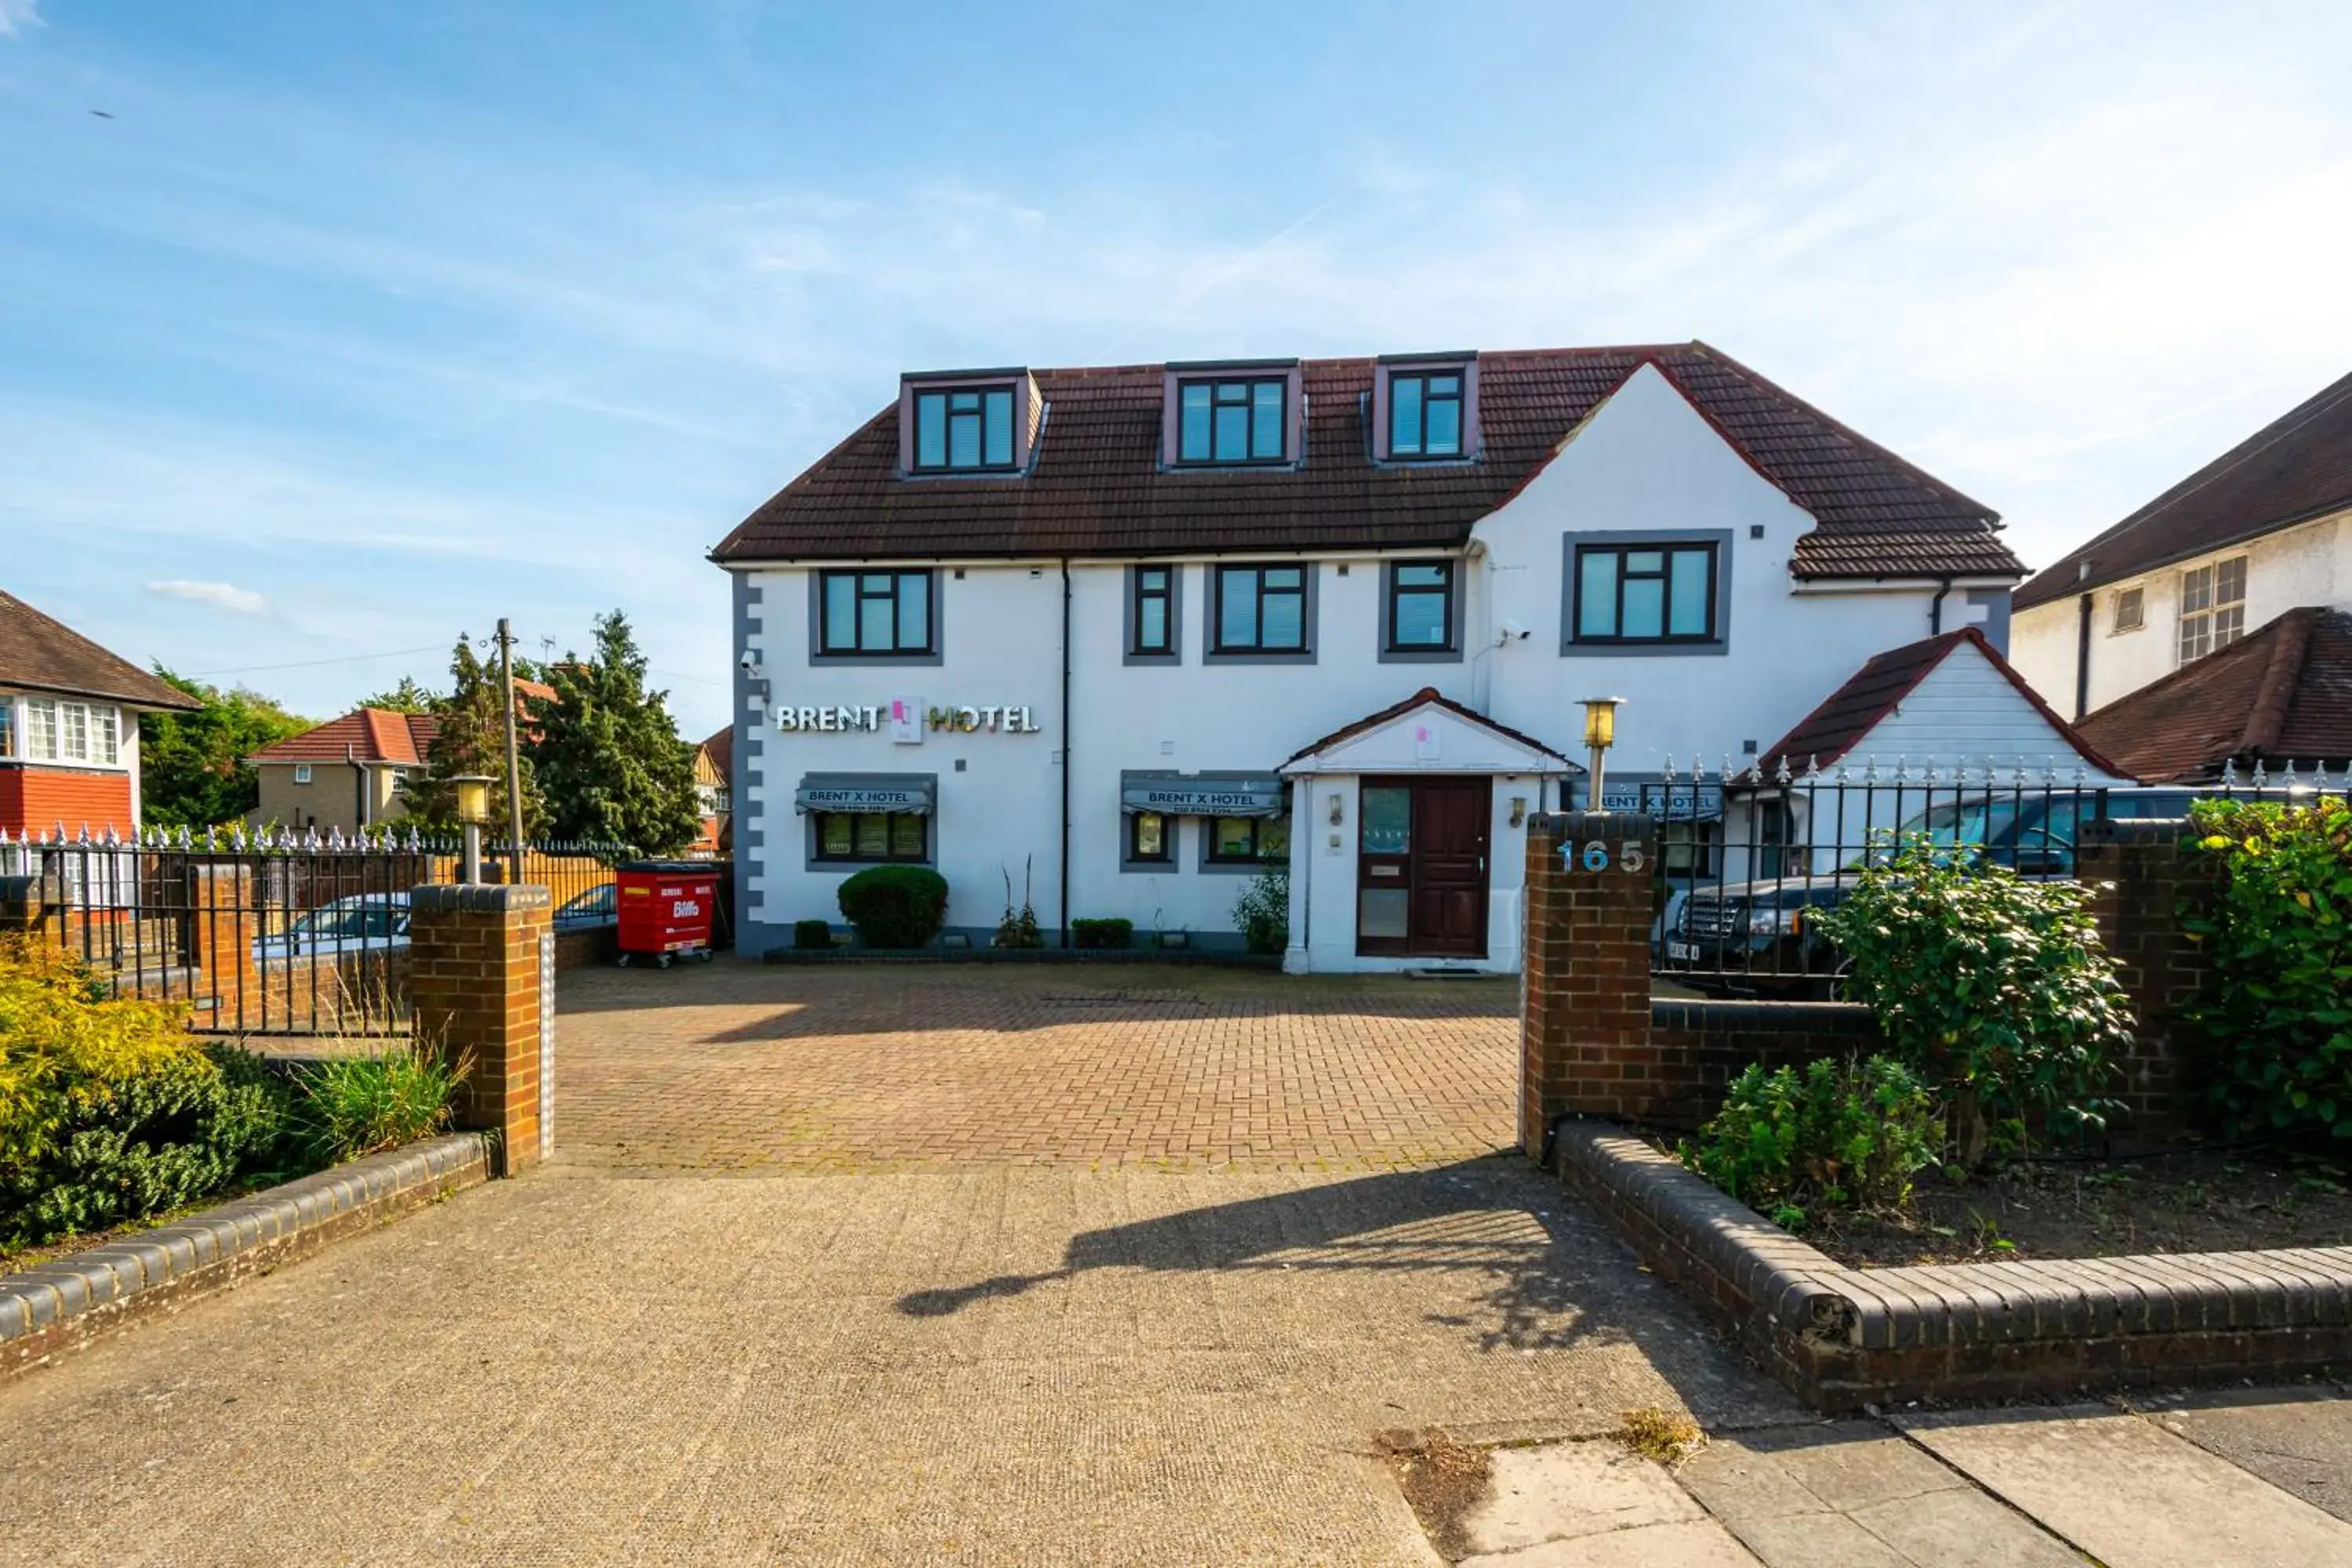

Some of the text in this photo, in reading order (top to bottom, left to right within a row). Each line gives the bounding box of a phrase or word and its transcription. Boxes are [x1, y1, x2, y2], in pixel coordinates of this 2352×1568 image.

[777, 705, 1040, 732] BRENT HOTEL
[809, 791, 908, 801] BRENT X HOTEL
[1149, 793, 1254, 804] BRENT X HOTEL
[1587, 796, 1638, 807] RENT
[1557, 840, 1644, 873] 165
